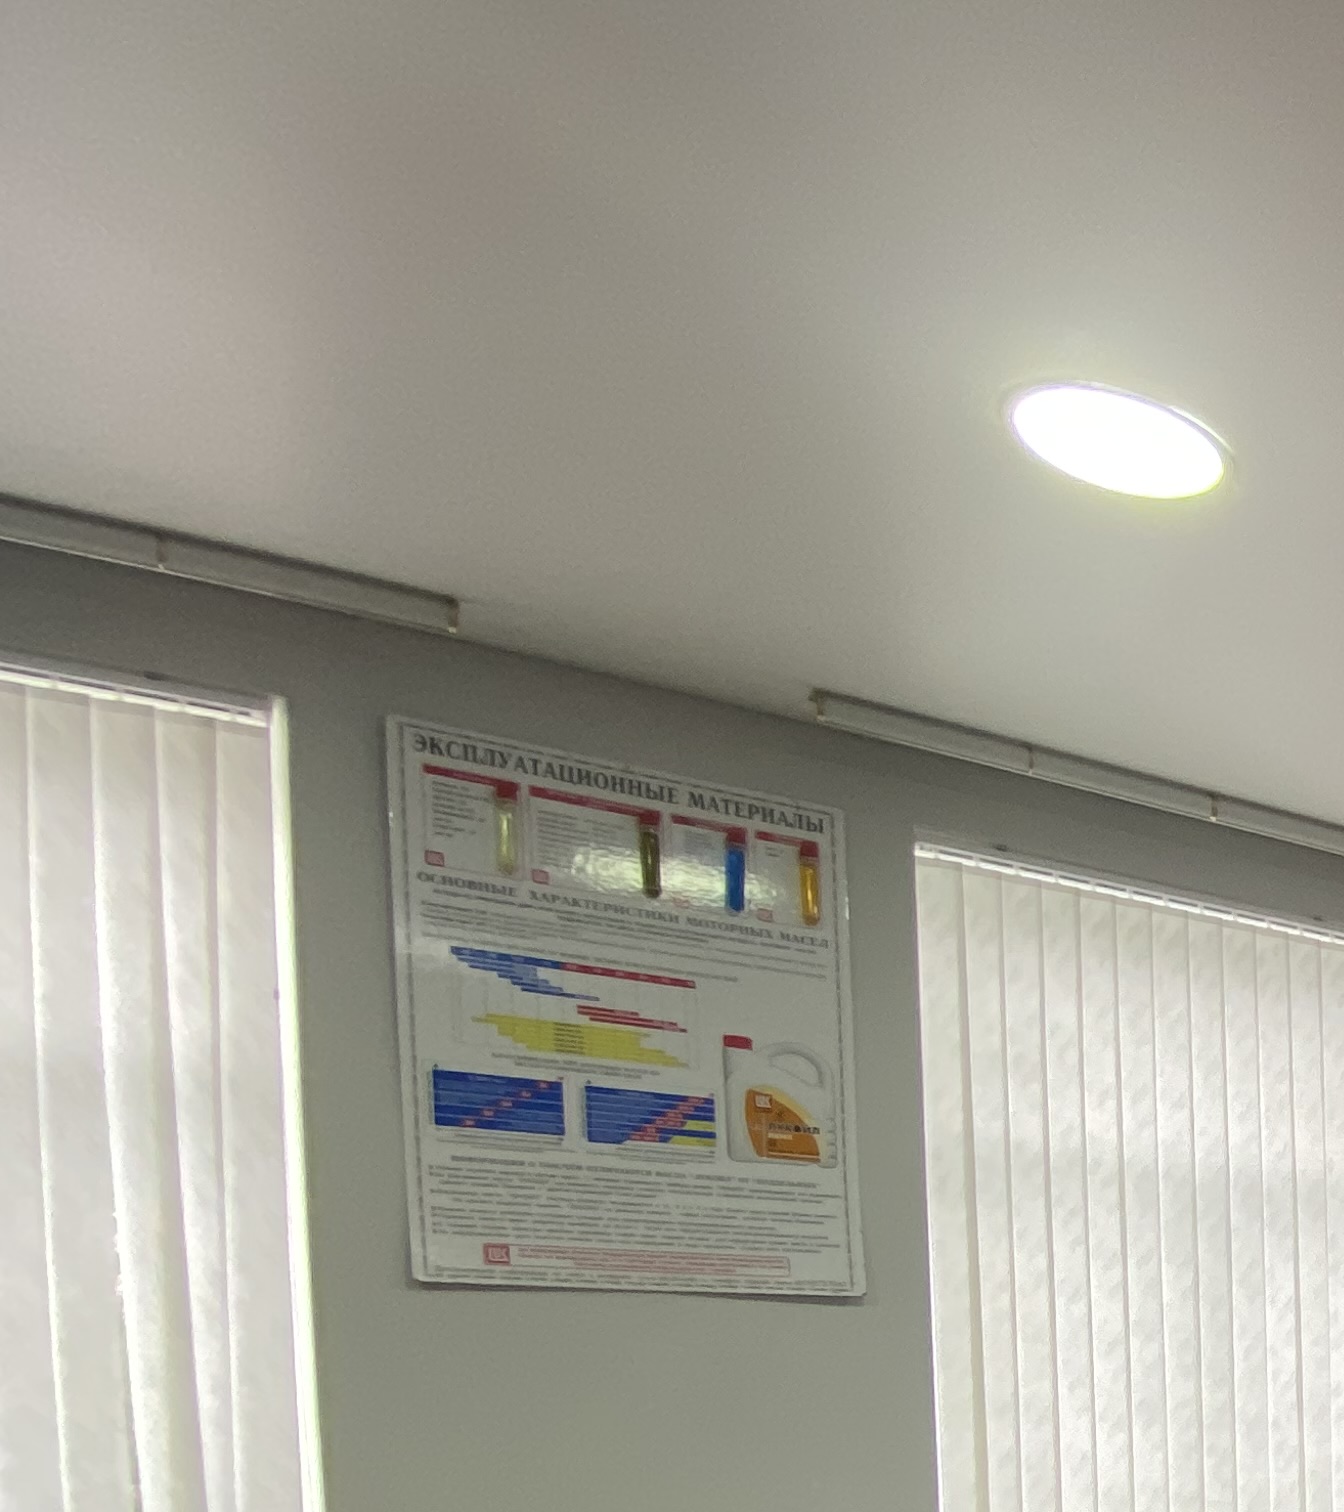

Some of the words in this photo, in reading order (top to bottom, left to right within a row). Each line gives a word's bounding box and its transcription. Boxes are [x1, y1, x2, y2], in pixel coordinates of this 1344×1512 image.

[413, 733, 679, 804] ЭКСПЛУАТАЦИОННЫЕ
[687, 791, 824, 834] МАТЕРИАЛЫ
[416, 871, 518, 897] ОСНОВНЫЕ
[529, 890, 679, 924] ХАРАКТЕРИСТИКИ
[779, 931, 830, 949] МАСЕЛ
